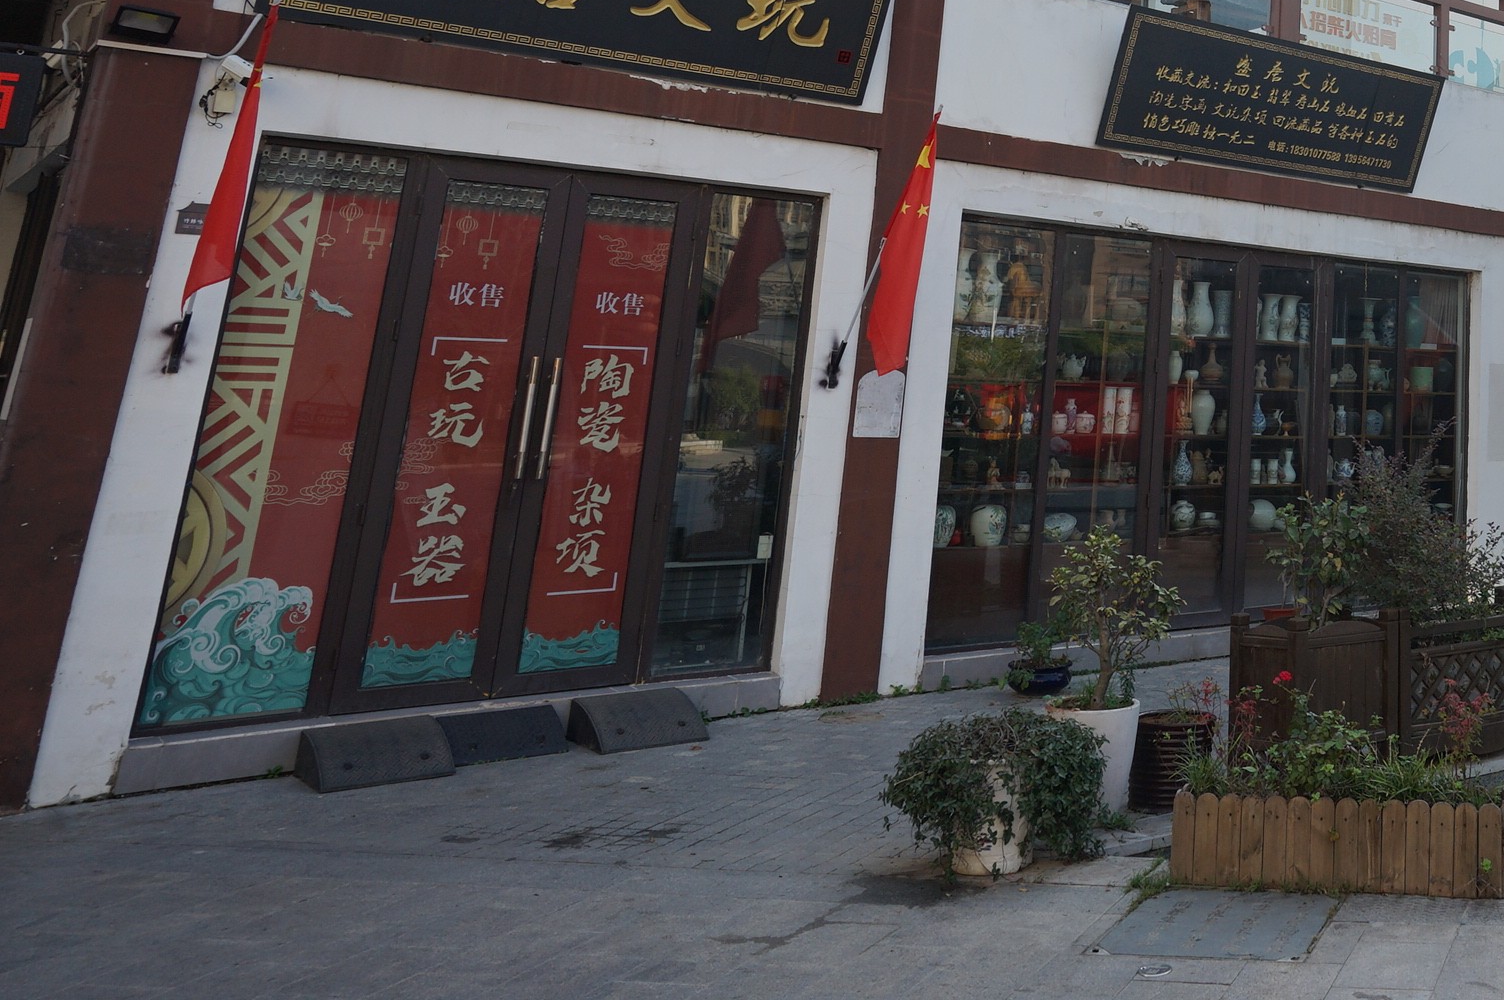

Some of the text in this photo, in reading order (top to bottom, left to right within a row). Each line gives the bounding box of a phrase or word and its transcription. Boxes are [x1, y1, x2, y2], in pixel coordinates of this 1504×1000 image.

[448, 281, 504, 308] 收售
[595, 291, 645, 316] 收售
[400, 350, 491, 587] 古玩 玉器
[556, 355, 635, 578] 陶瓷 杂项
